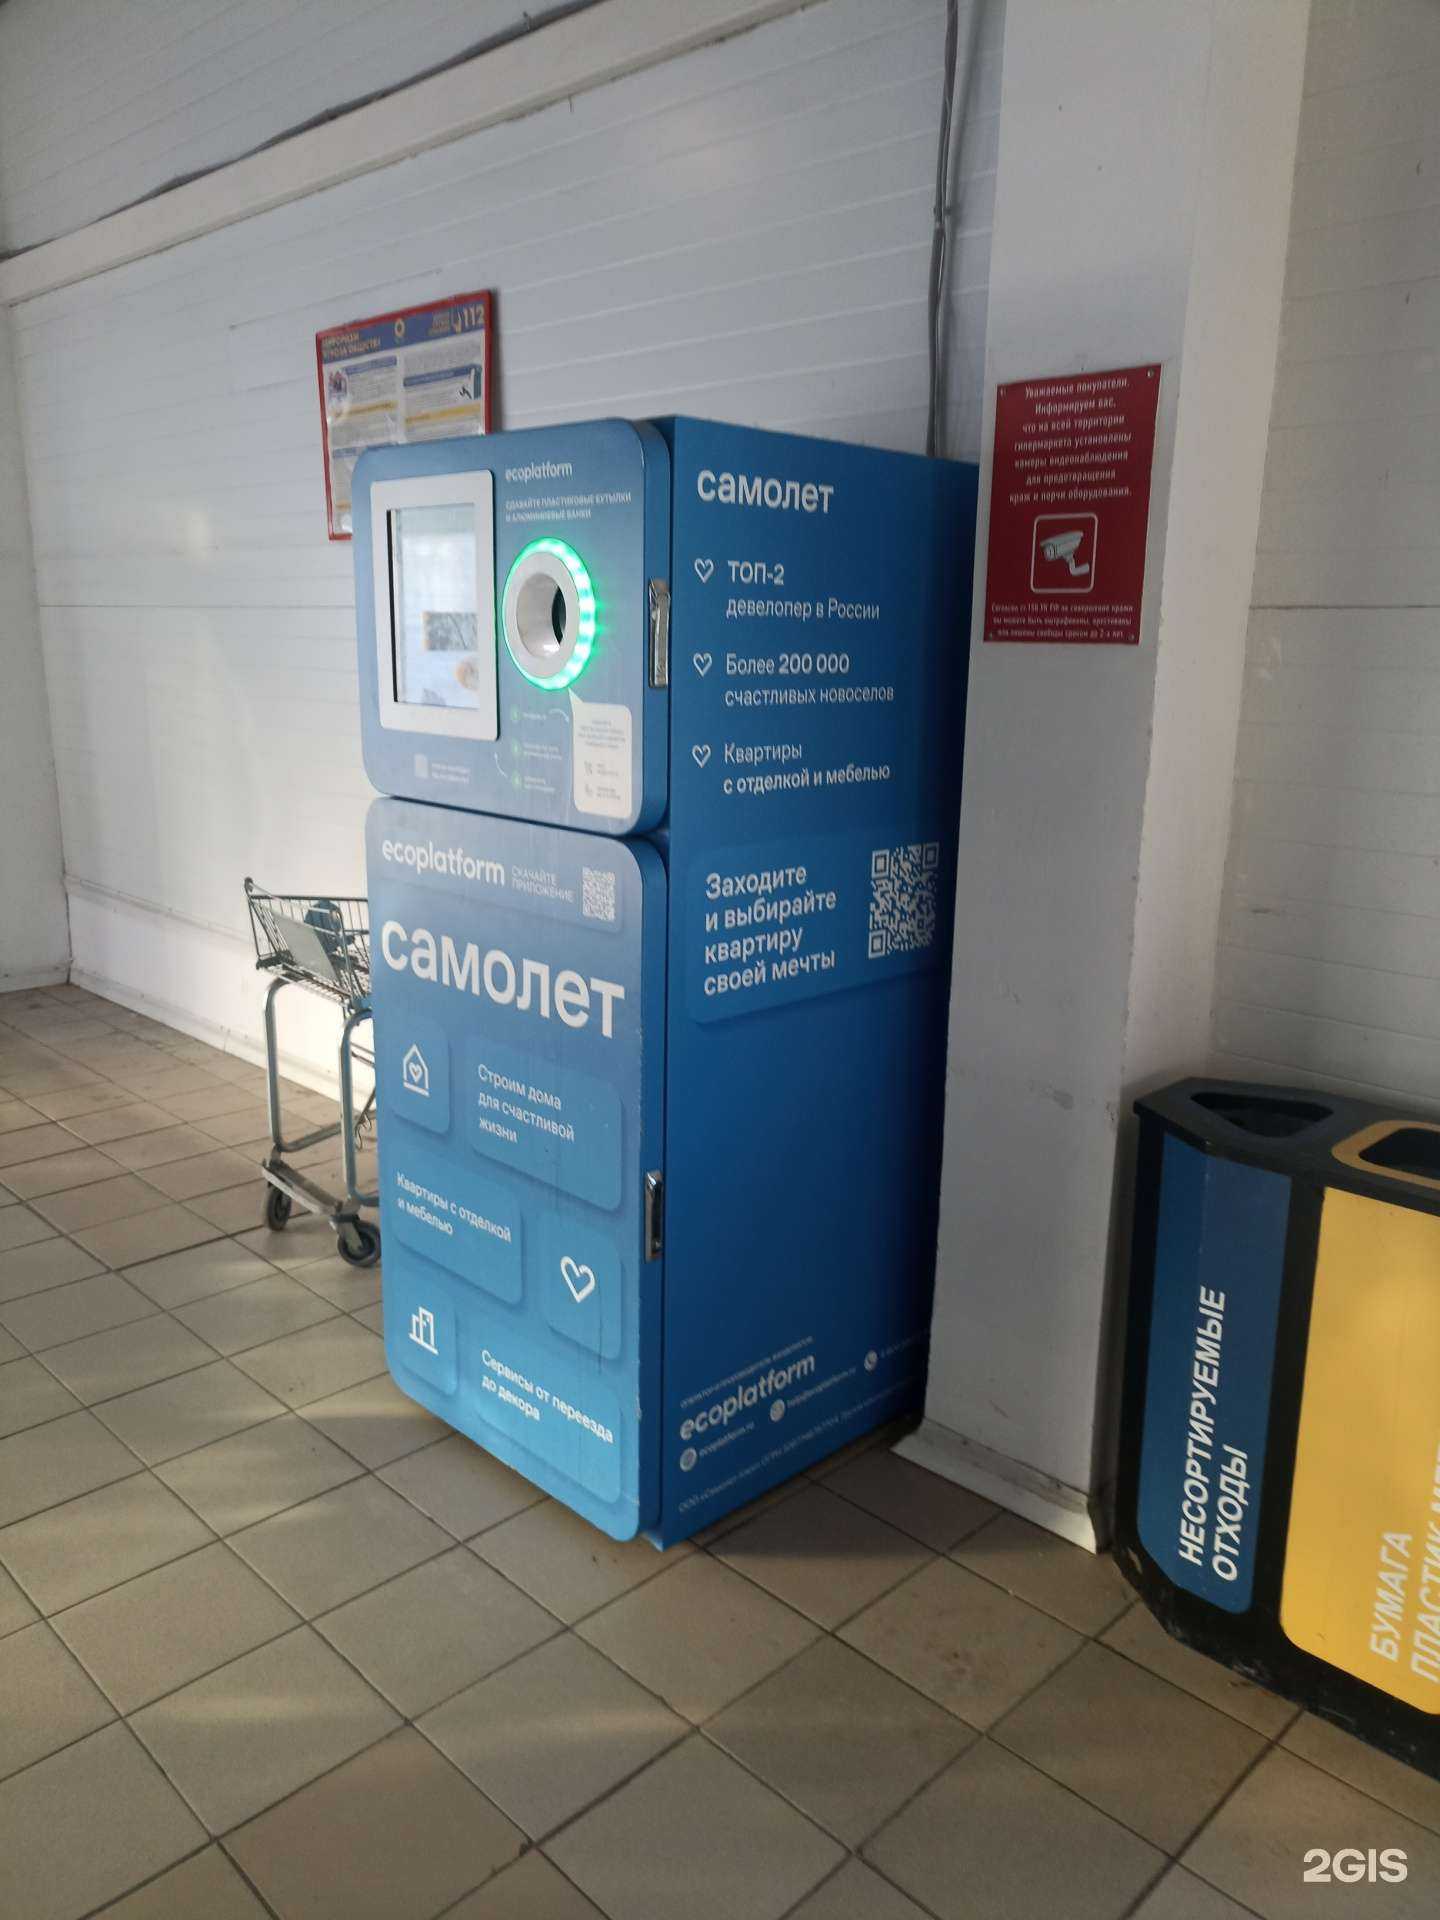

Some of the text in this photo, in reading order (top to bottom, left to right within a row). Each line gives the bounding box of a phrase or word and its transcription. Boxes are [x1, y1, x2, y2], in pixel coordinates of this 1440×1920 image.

[463, 304, 484, 327] 112
[1025, 385, 1074, 399] Уважаемые
[1035, 400, 1096, 416] Информируем
[1023, 415, 1125, 433] что на всей территории
[1014, 433, 1132, 452] гипермаркета установлены
[505, 461, 572, 484] ecoplatform
[1014, 451, 1128, 470] камеры видеонаблюдения
[697, 469, 834, 513] самолет
[1026, 475, 1041, 486] для
[1009, 493, 1031, 506] краж
[1033, 492, 1039, 501] и
[1041, 489, 1066, 503] порчи
[727, 560, 784, 585] ТОП-2
[726, 598, 880, 621] девелопер в России
[726, 653, 850, 676] Более 200 000
[725, 686, 894, 707] счастливых новоселов
[724, 743, 802, 766] Квартиры
[723, 764, 890, 795] с отделкой и мебелью
[382, 839, 505, 887] ecoplatform
[511, 865, 557, 885] СКАЧАЙТЕ
[511, 878, 575, 903] ПРИЛОЖЕНИЕ
[705, 866, 807, 900] Заходите
[705, 890, 837, 932] и выбирайте
[705, 927, 803, 964] квартиру
[381, 920, 625, 1039] самолет
[704, 950, 836, 996] своей мечты
[478, 1064, 562, 1111] Строим дома
[478, 1092, 575, 1142] для счастливой
[479, 1117, 518, 1143] жизни
[396, 1171, 512, 1243] Квартиры с отделкой
[397, 1198, 453, 1236] и мебелью
[481, 1350, 614, 1444] Сервисы от переезда
[481, 1375, 541, 1422] до декора
[680, 1354, 816, 1441] ecoplatform
[1178, 1285, 1227, 1567] НЕСОРТИРУЕМЫЕ
[1212, 1443, 1251, 1582] ОТХОДЫ
[1369, 1530, 1413, 1663] БУМАГА
